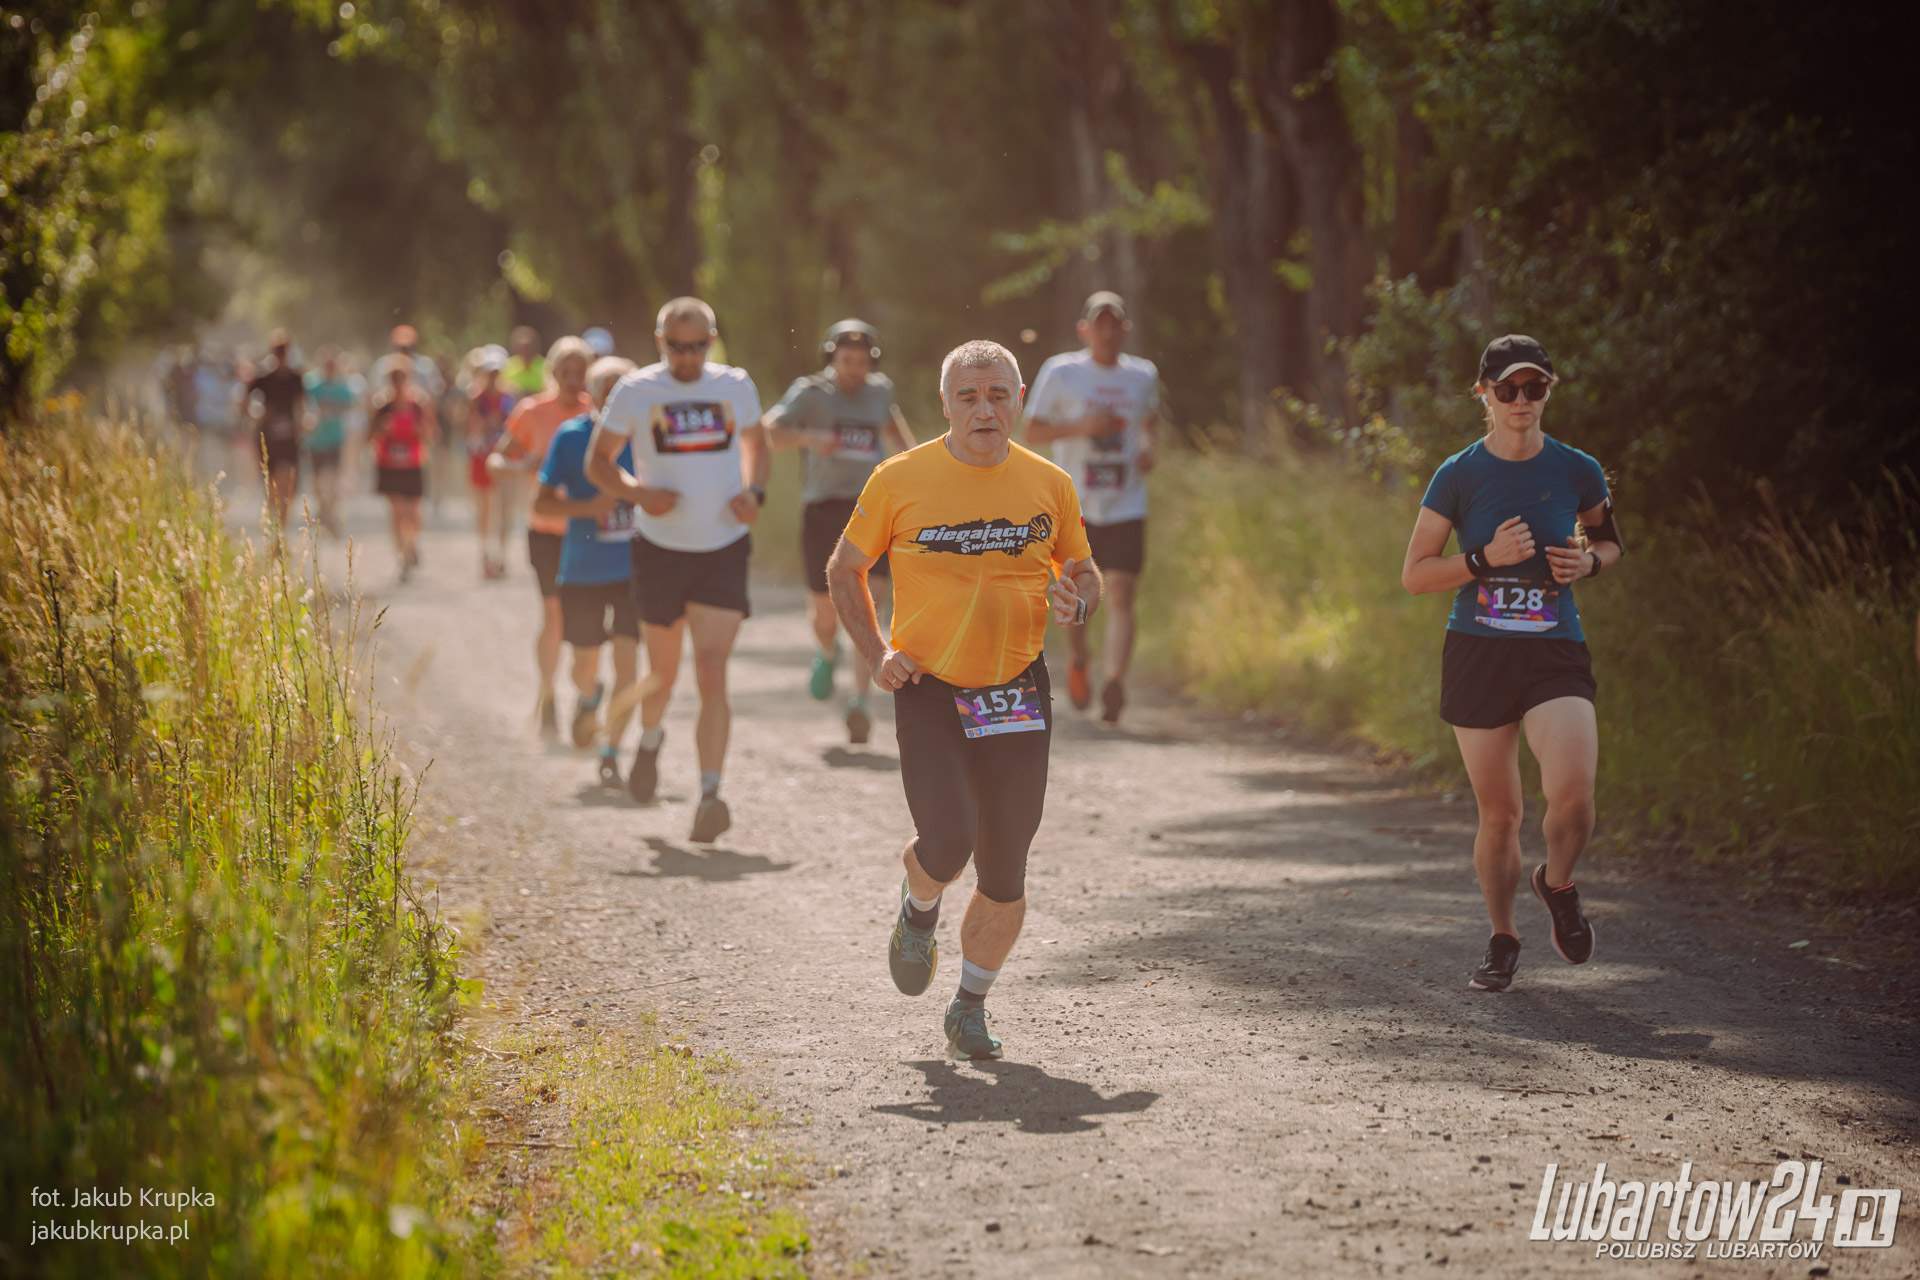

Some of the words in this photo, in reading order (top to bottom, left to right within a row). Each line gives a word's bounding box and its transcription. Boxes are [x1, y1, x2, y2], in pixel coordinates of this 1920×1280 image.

[918, 523, 1029, 542] Biegający
[1493, 587, 1543, 611] 128
[973, 688, 1026, 716] 152
